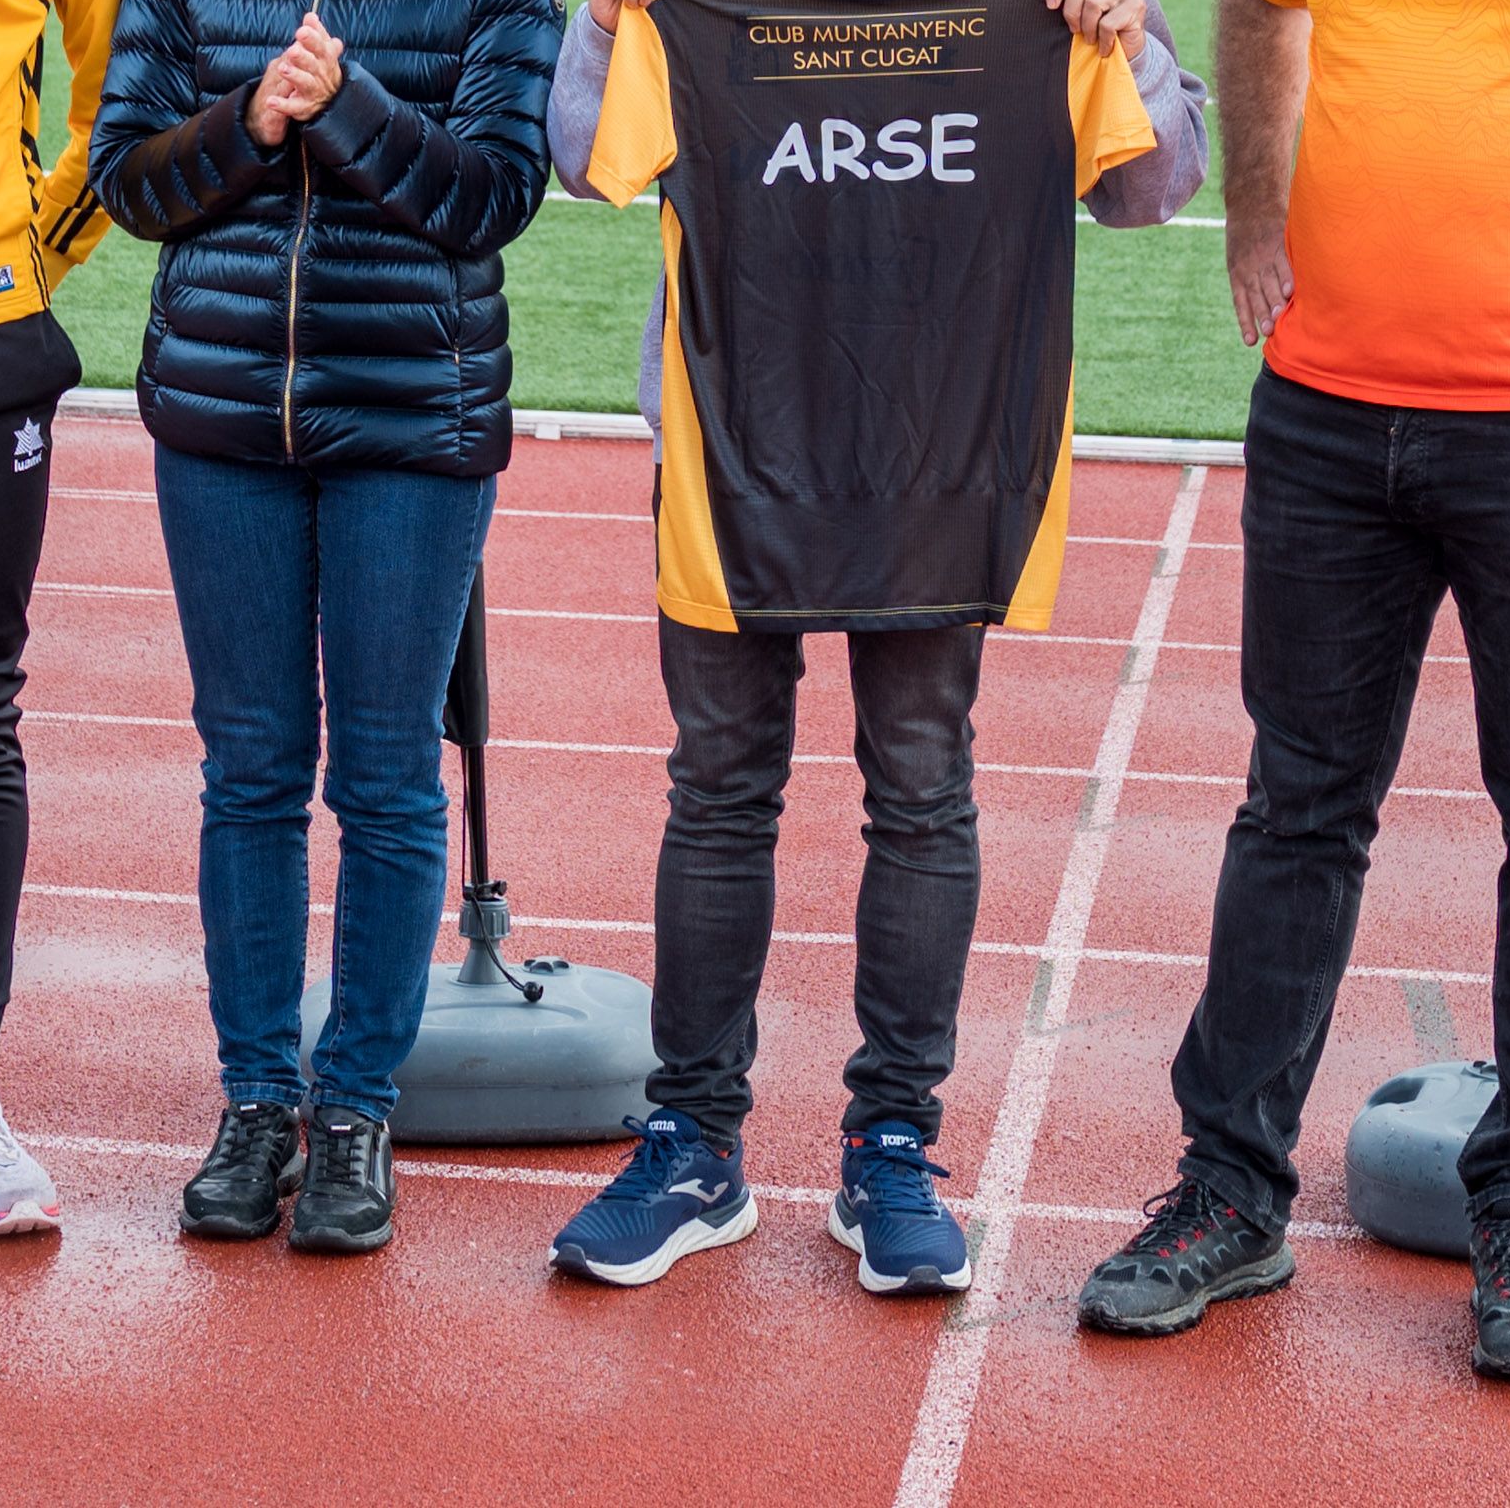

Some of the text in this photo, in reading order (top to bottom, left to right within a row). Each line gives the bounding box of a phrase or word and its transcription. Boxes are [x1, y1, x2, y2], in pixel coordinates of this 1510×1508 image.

[749, 17, 986, 44] CLUB MUNTANYENC
[793, 46, 943, 70] SANT CUGAT
[762, 112, 979, 185] ARSE
